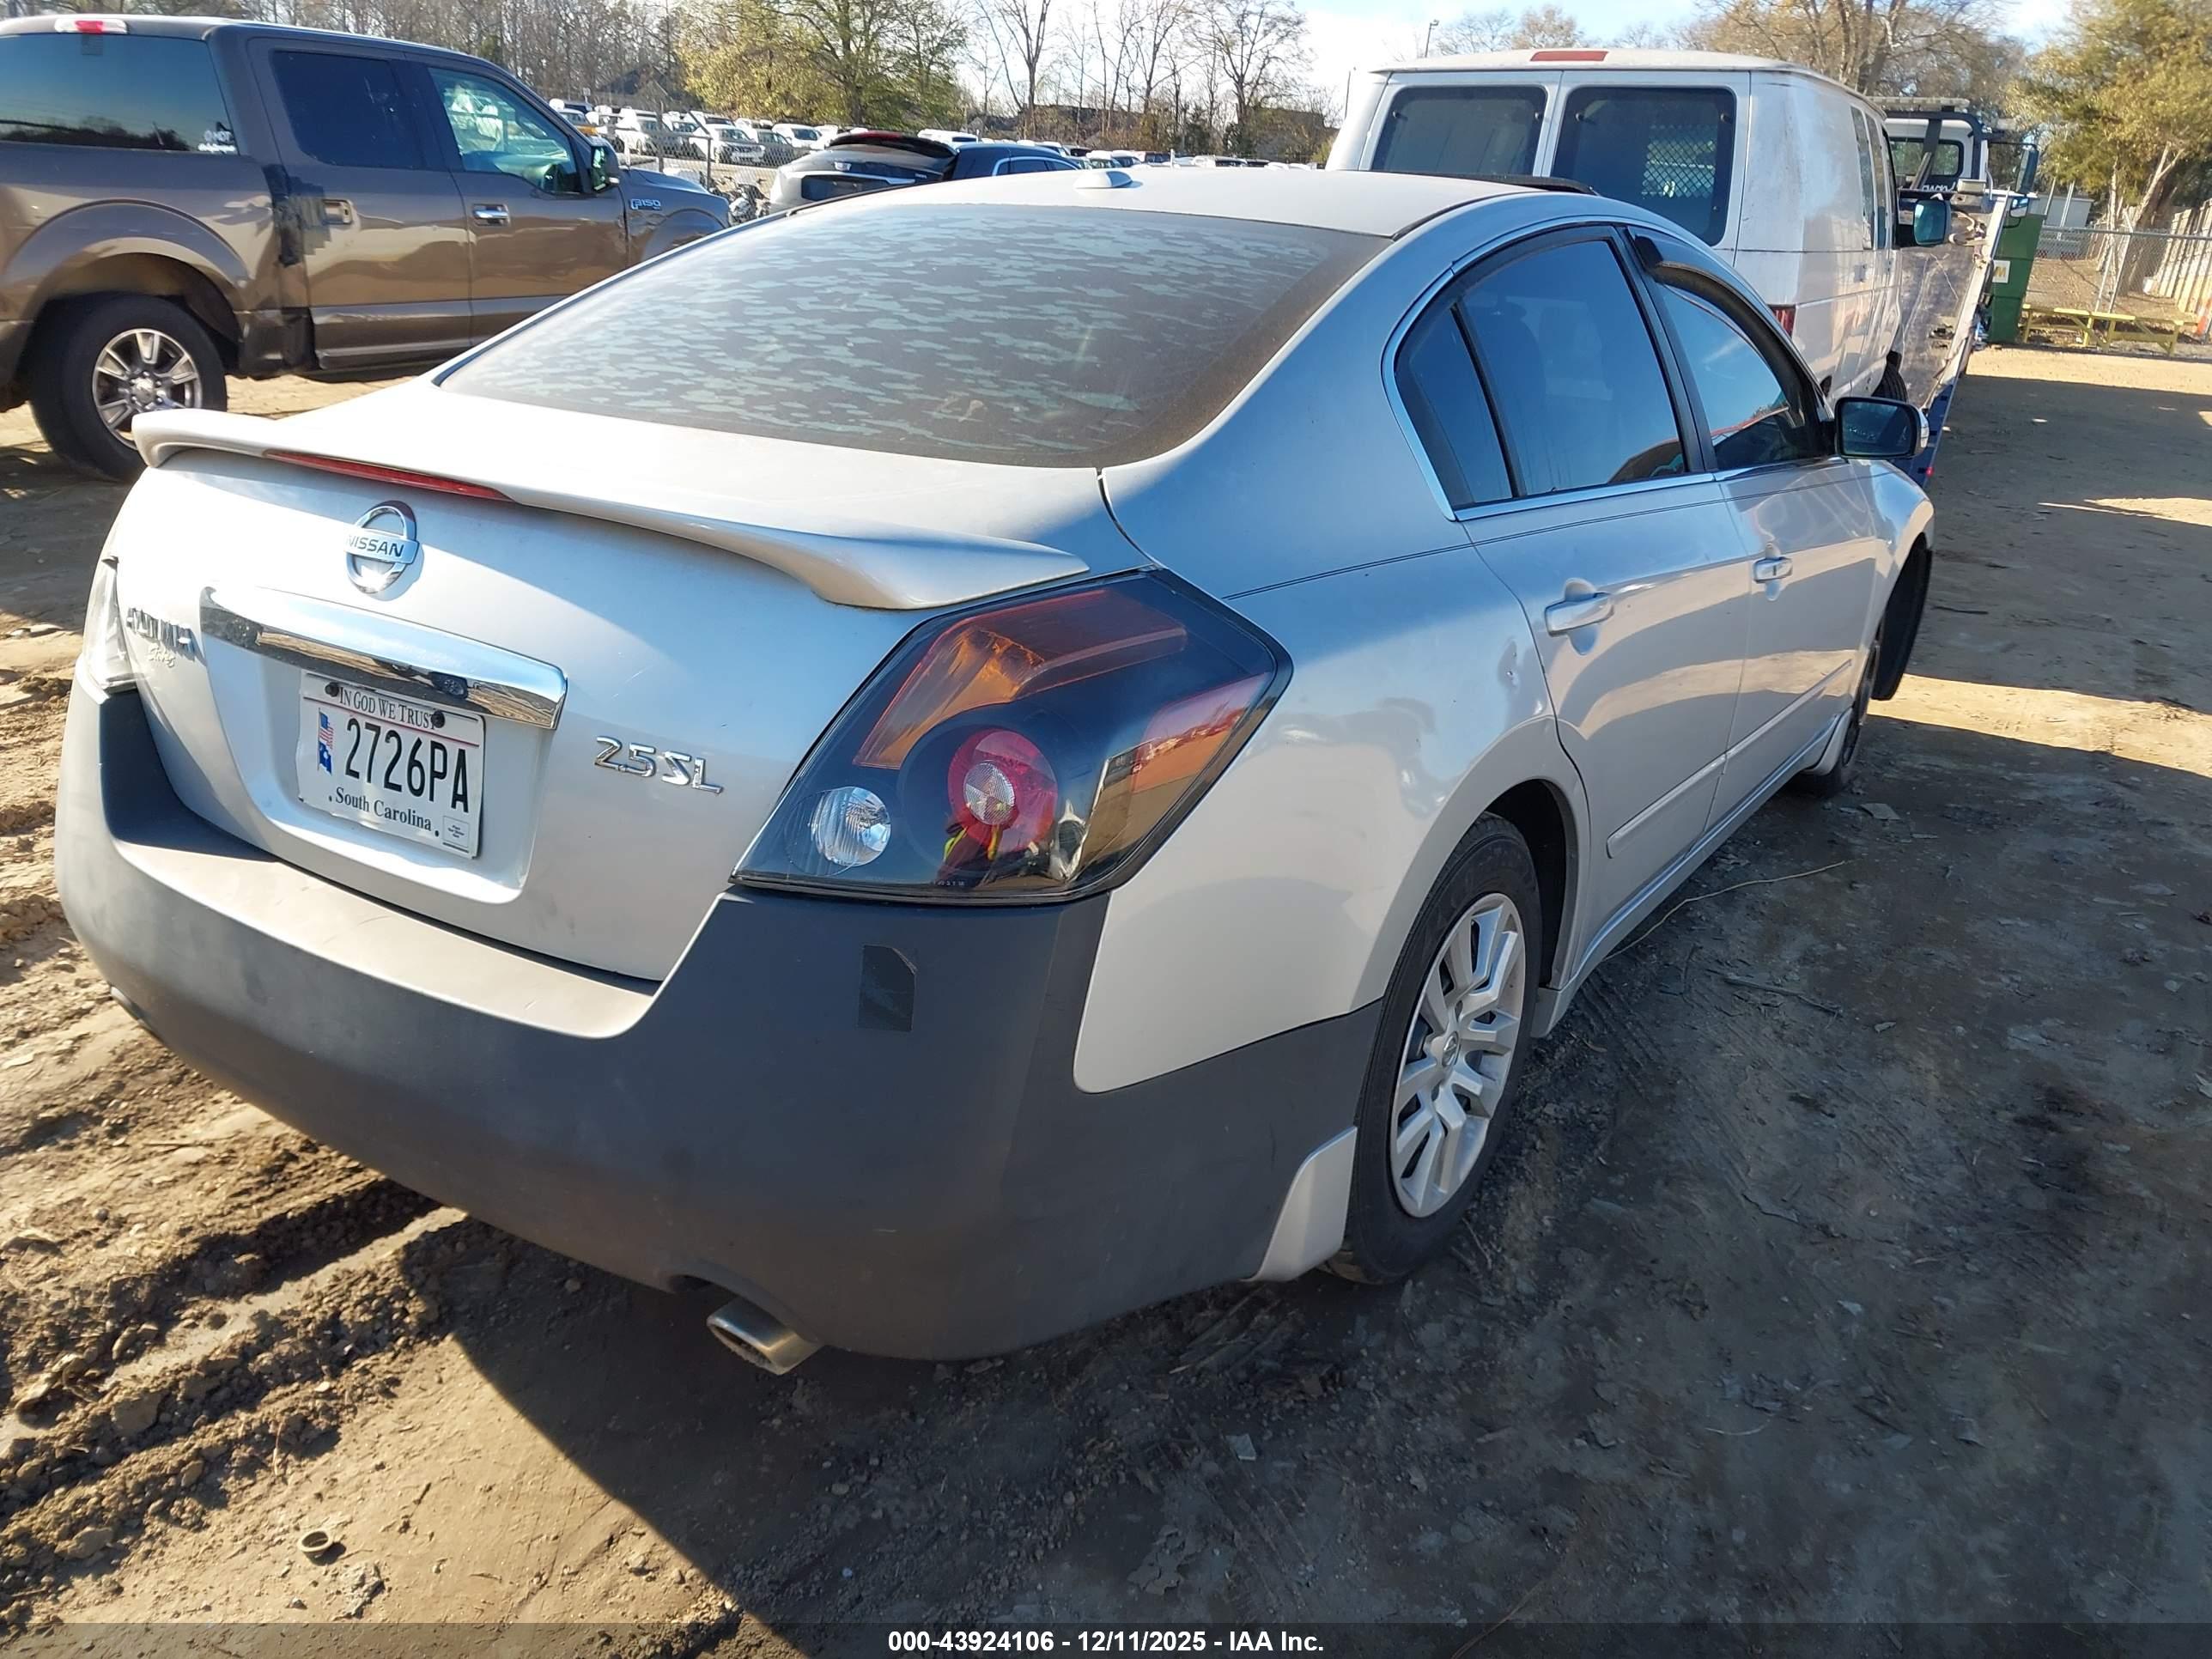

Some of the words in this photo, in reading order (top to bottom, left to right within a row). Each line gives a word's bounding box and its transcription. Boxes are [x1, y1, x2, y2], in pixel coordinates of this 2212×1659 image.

[346, 534, 404, 557] NISSAN
[340, 687, 351, 706] IN
[353, 690, 376, 714] GOD
[378, 696, 396, 720] WE
[345, 718, 469, 813] 2726PA
[336, 787, 370, 812] South
[374, 799, 432, 831] Carolina
